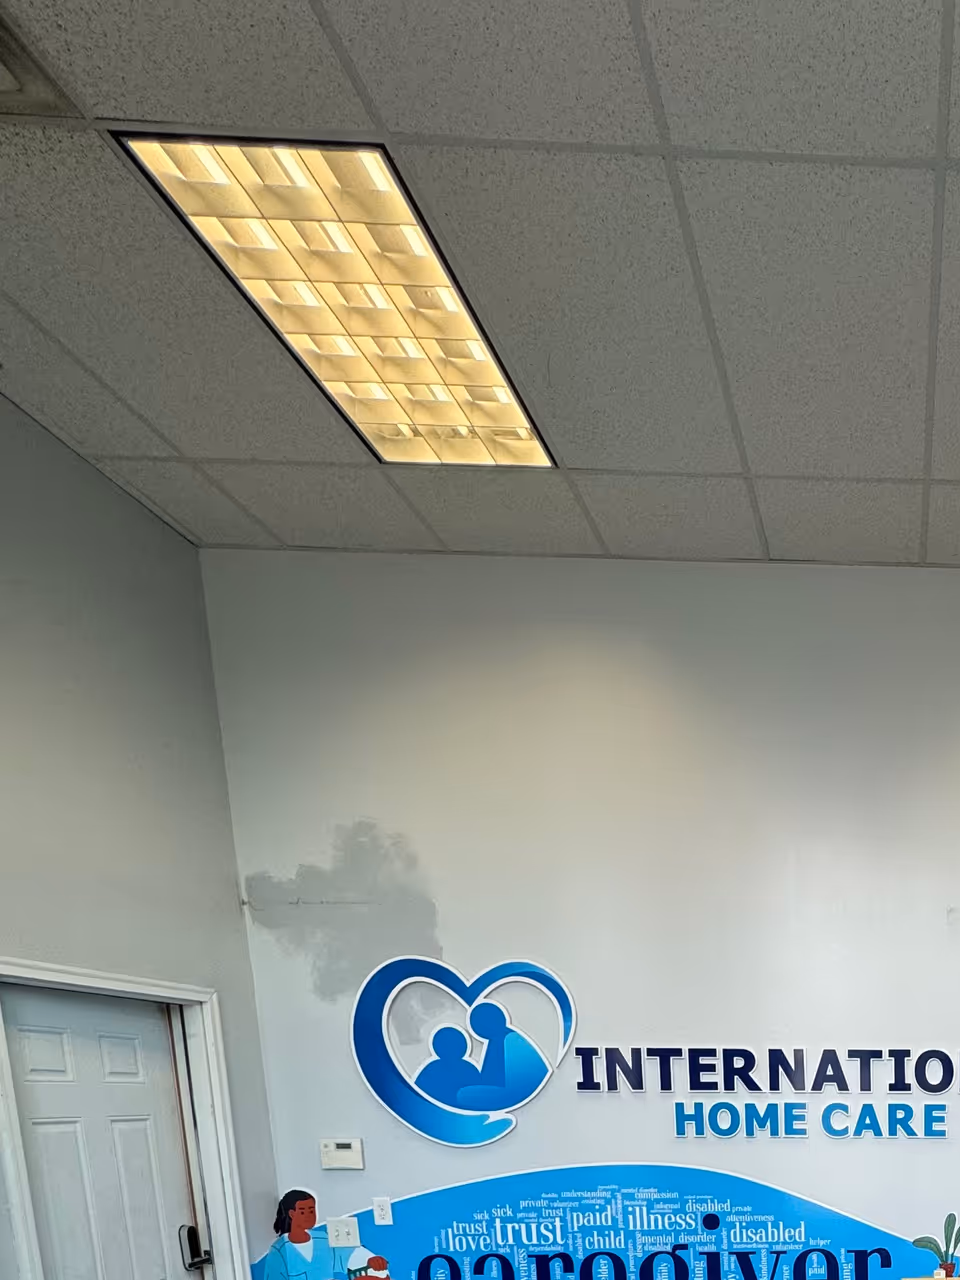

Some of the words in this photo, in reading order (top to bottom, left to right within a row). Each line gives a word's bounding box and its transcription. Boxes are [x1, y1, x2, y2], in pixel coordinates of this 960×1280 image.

[675, 1101, 808, 1138] HOME
[820, 1101, 948, 1138] CARE
[491, 1204, 513, 1217] sick
[520, 1198, 549, 1209] private
[542, 1207, 564, 1217] trust
[686, 1198, 731, 1213] disabled
[473, 1210, 490, 1221] sick
[572, 1205, 613, 1231] paid
[628, 1206, 696, 1230] illness
[453, 1220, 488, 1235] trust
[494, 1217, 566, 1245] trust
[730, 1221, 806, 1243] disabled
[447, 1228, 491, 1252] love
[585, 1230, 625, 1249] child
[642, 1233, 675, 1243] mental
[679, 1232, 716, 1243] disorder
[759, 1248, 768, 1280] kindness
